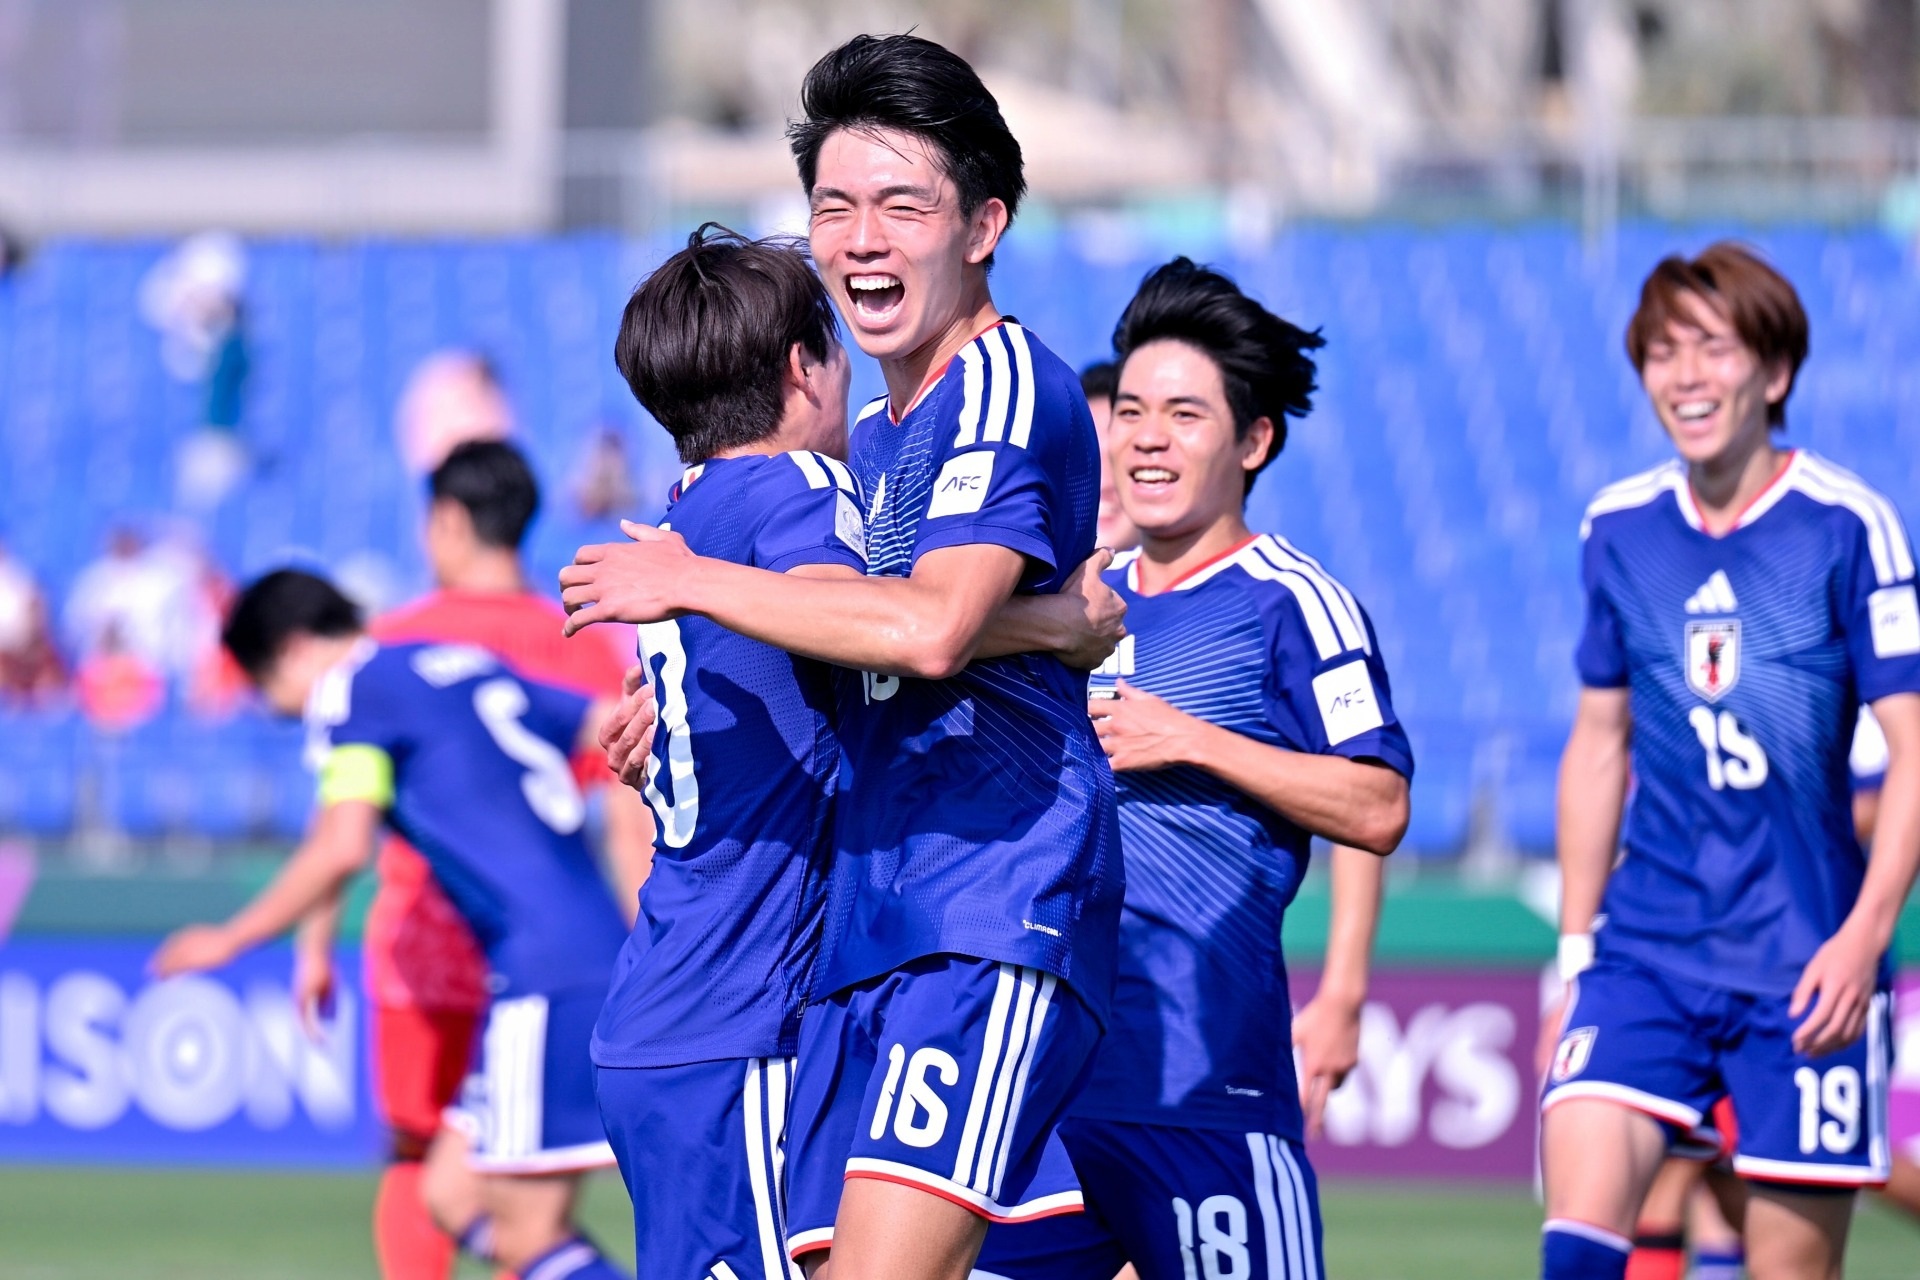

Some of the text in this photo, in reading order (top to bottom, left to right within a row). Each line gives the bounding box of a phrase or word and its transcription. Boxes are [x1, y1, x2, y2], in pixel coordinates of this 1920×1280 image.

[941, 475, 982, 492] AFC
[1330, 688, 1365, 714] AFC
[869, 1043, 960, 1148] 16
[1794, 1065, 1861, 1155] 19
[1172, 1194, 1251, 1280] 18
